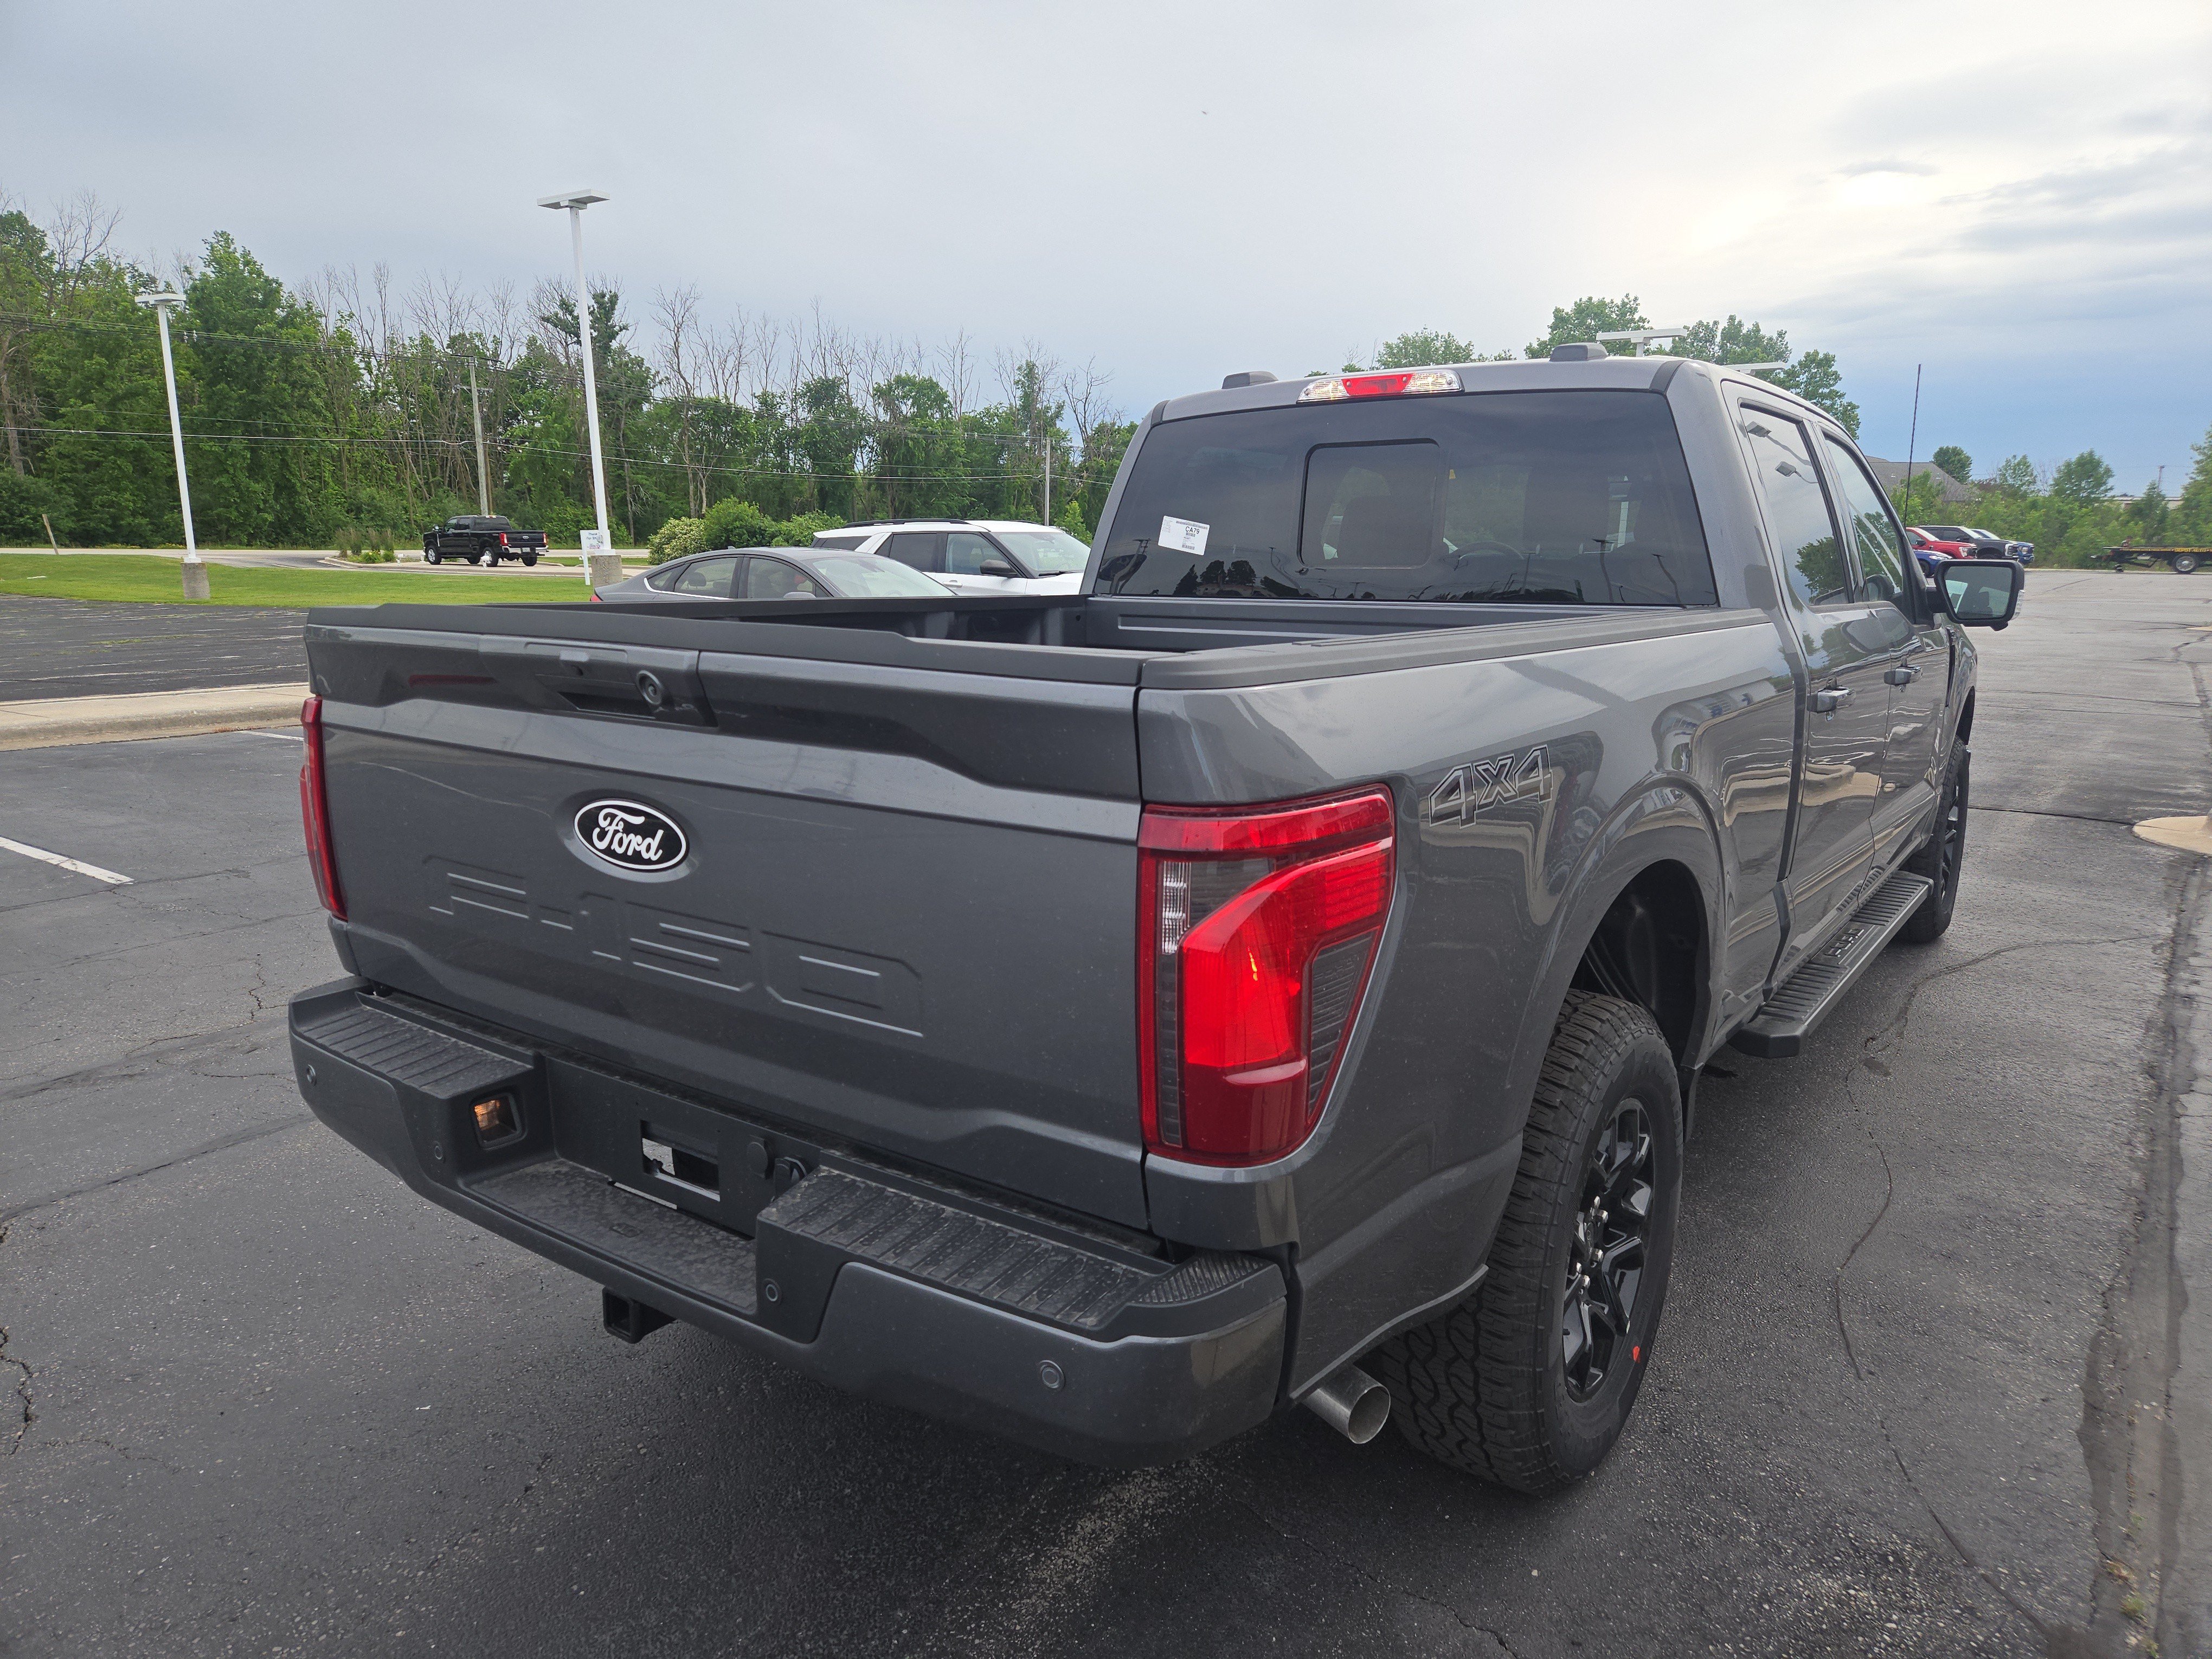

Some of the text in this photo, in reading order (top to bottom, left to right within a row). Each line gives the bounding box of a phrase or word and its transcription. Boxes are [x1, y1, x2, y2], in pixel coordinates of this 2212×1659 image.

[1186, 526, 1200, 534] CA79
[593, 808, 664, 861] Ford
[422, 855, 925, 1038] F-150
